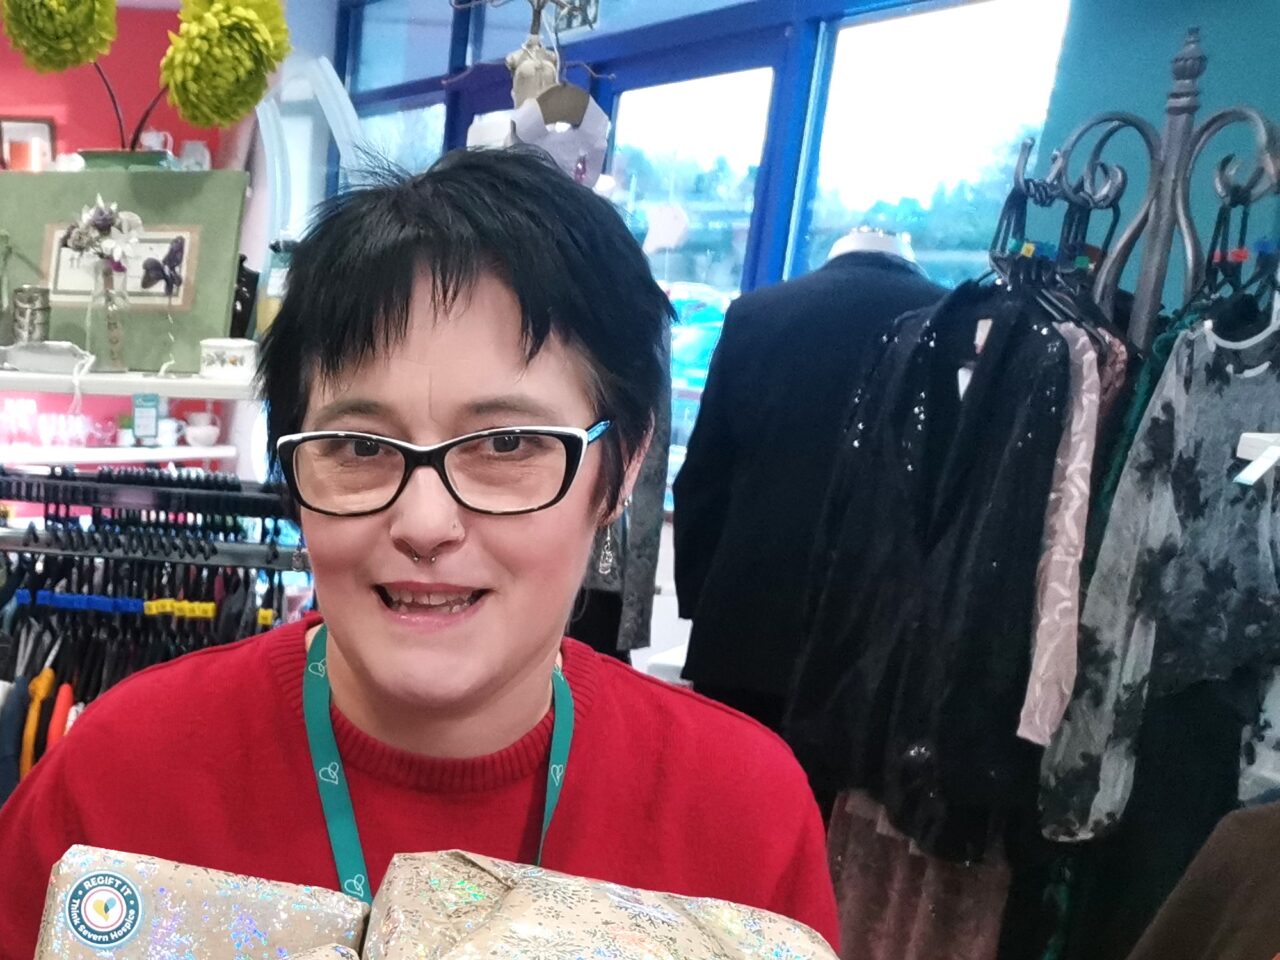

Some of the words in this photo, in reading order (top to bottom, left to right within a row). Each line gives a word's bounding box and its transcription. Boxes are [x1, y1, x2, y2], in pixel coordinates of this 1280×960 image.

[83, 876, 122, 890] REGIFT
[120, 885, 133, 896] IT
[70, 898, 81, 926] Think
[78, 924, 109, 942] Severn
[109, 909, 136, 940] Hospice
